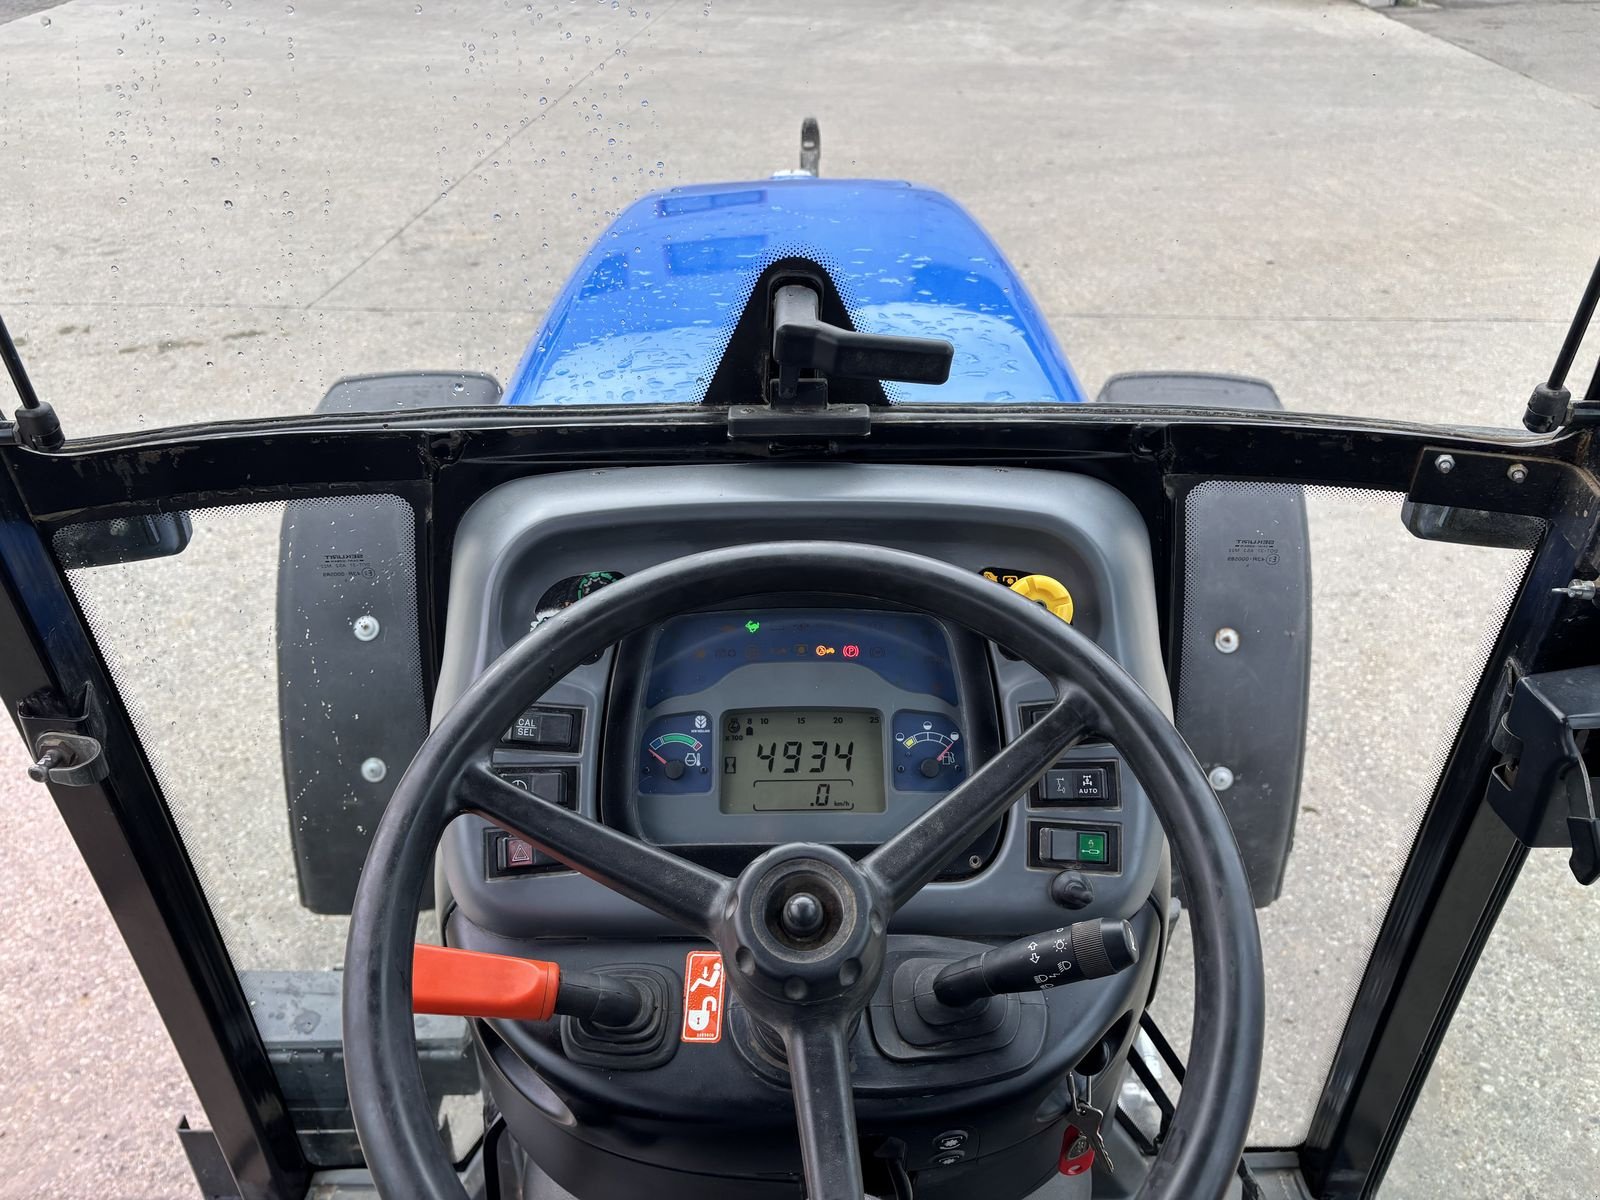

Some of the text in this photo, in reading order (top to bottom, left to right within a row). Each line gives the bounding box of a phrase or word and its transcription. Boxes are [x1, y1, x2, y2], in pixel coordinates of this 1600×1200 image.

[518, 718, 536, 727] CAL
[747, 716, 880, 725] 8 10 15 20 25
[517, 727, 535, 737] SEL
[757, 741, 853, 773] 4934
[833, 799, 850, 807] km/h
